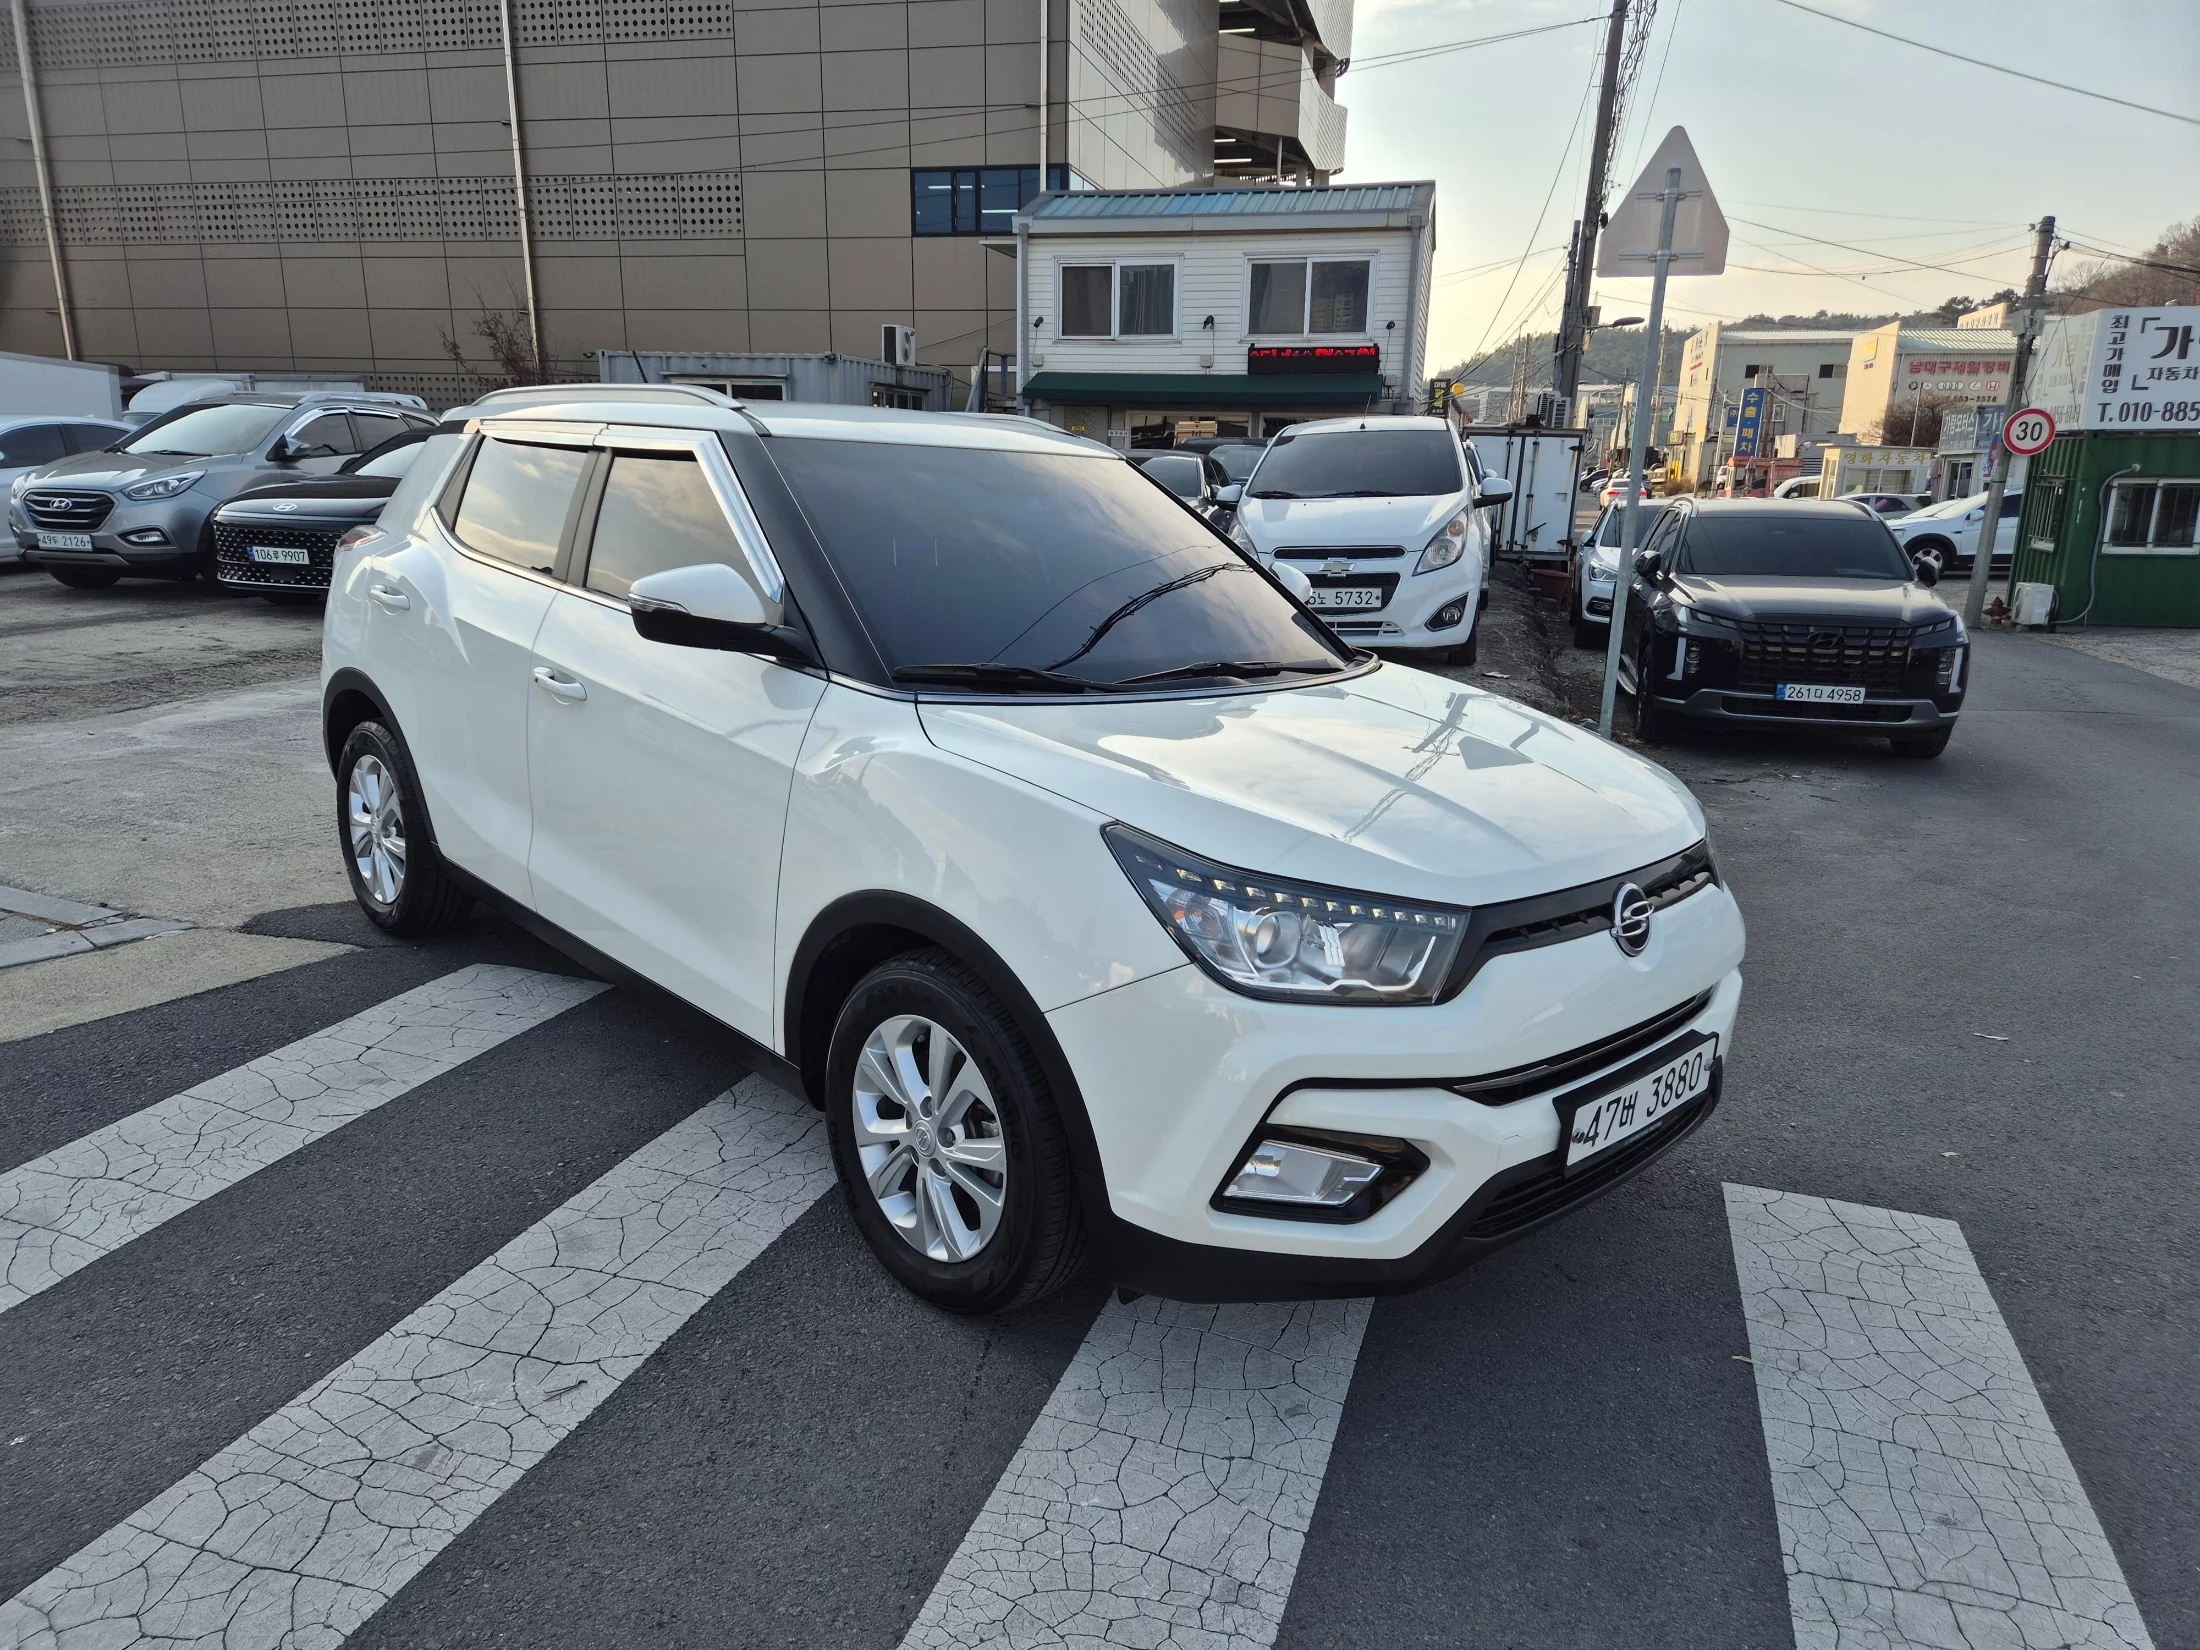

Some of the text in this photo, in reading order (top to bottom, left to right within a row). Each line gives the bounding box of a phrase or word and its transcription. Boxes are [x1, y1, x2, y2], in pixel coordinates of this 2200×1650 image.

[2150, 325, 2200, 360] 가
[2101, 315, 2130, 394] 최고가매입
[1909, 361, 2011, 376] 남대구제일정비
[2015, 421, 2043, 442] 30
[61, 536, 86, 547] 2126
[281, 550, 306, 562] 9907
[1334, 590, 1373, 605] 5732
[1787, 686, 1862, 702] 261다 4958
[1583, 1051, 1703, 1148] 47버 3880
